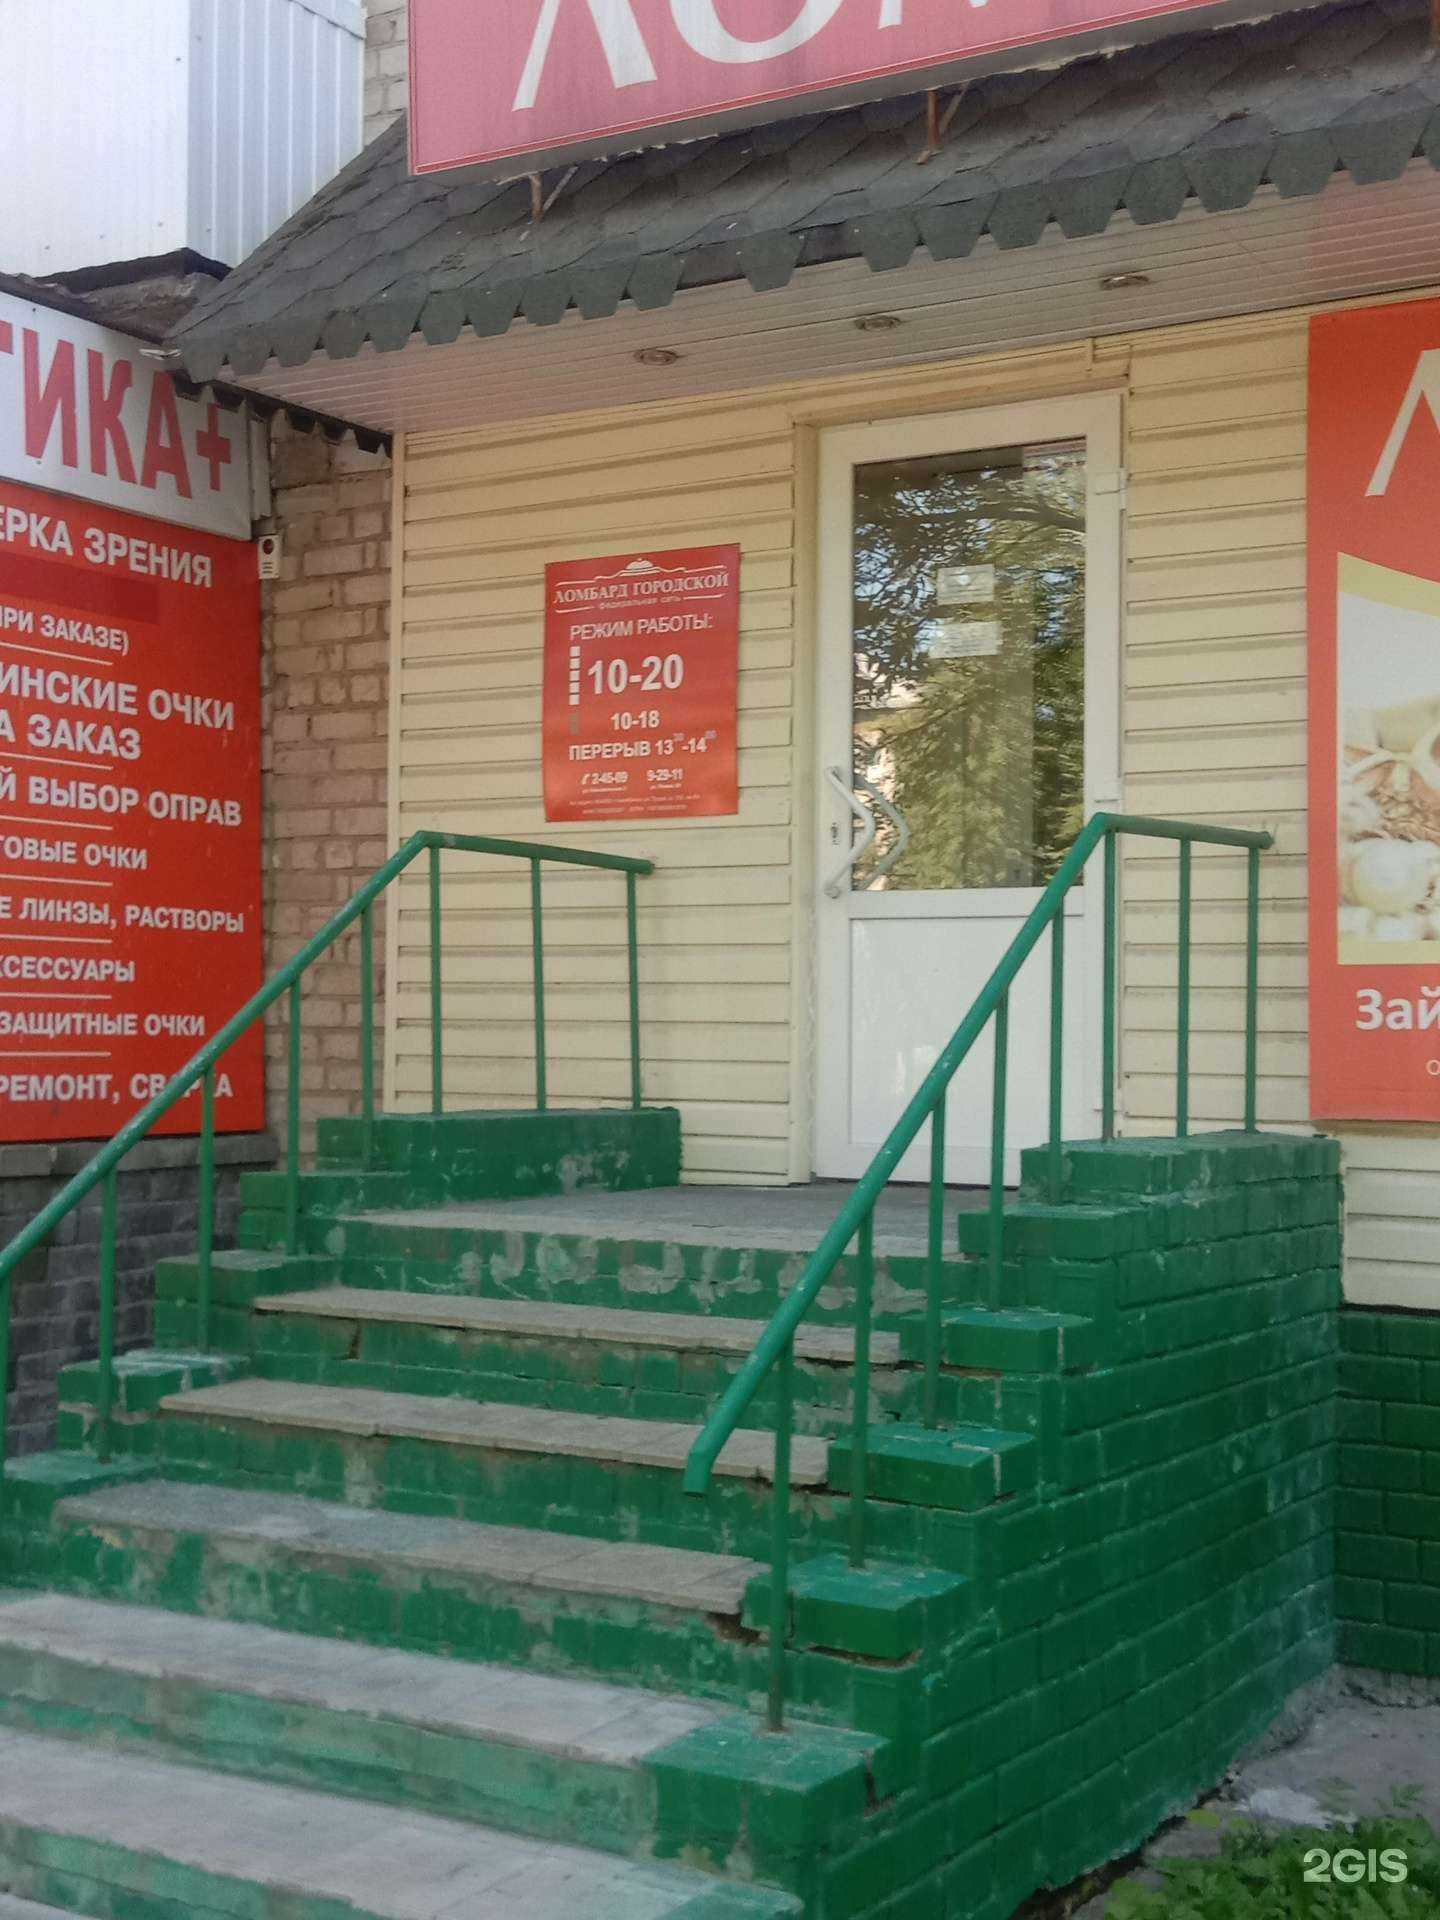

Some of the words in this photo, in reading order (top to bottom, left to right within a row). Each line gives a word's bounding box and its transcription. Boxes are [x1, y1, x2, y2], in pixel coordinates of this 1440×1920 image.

[0, 319, 232, 499] ИКА+
[83, 527, 212, 588] ЗРЕНИЯ
[554, 583, 628, 604] ЛОМБАРД
[633, 571, 729, 596] ГОРОДСКОЙ
[0, 605, 33, 634] РИ
[40, 614, 129, 656] ЗАКАЗЕ)
[570, 620, 634, 640] РЕЖИМ
[637, 613, 714, 635] РАБОТЫ:
[588, 653, 684, 695] 10-20
[148, 688, 235, 731] ОЧКИ
[610, 709, 661, 731] 10-18
[27, 713, 141, 760] ЗАКАЗ
[569, 741, 651, 761] ПЕРЕРЫВ
[28, 775, 140, 814] ВЫБОР
[148, 791, 242, 827] ОПРАВ
[84, 843, 148, 870] ОЧКИ
[18, 897, 117, 930] ЛИНЗЫ,
[125, 905, 244, 933] РАСТВОРЫ
[0, 955, 135, 983] СЕССУАРЫ
[0, 1010, 137, 1038] ЗАЩИТНЫЕ
[144, 1013, 205, 1037] ОЧКИ
